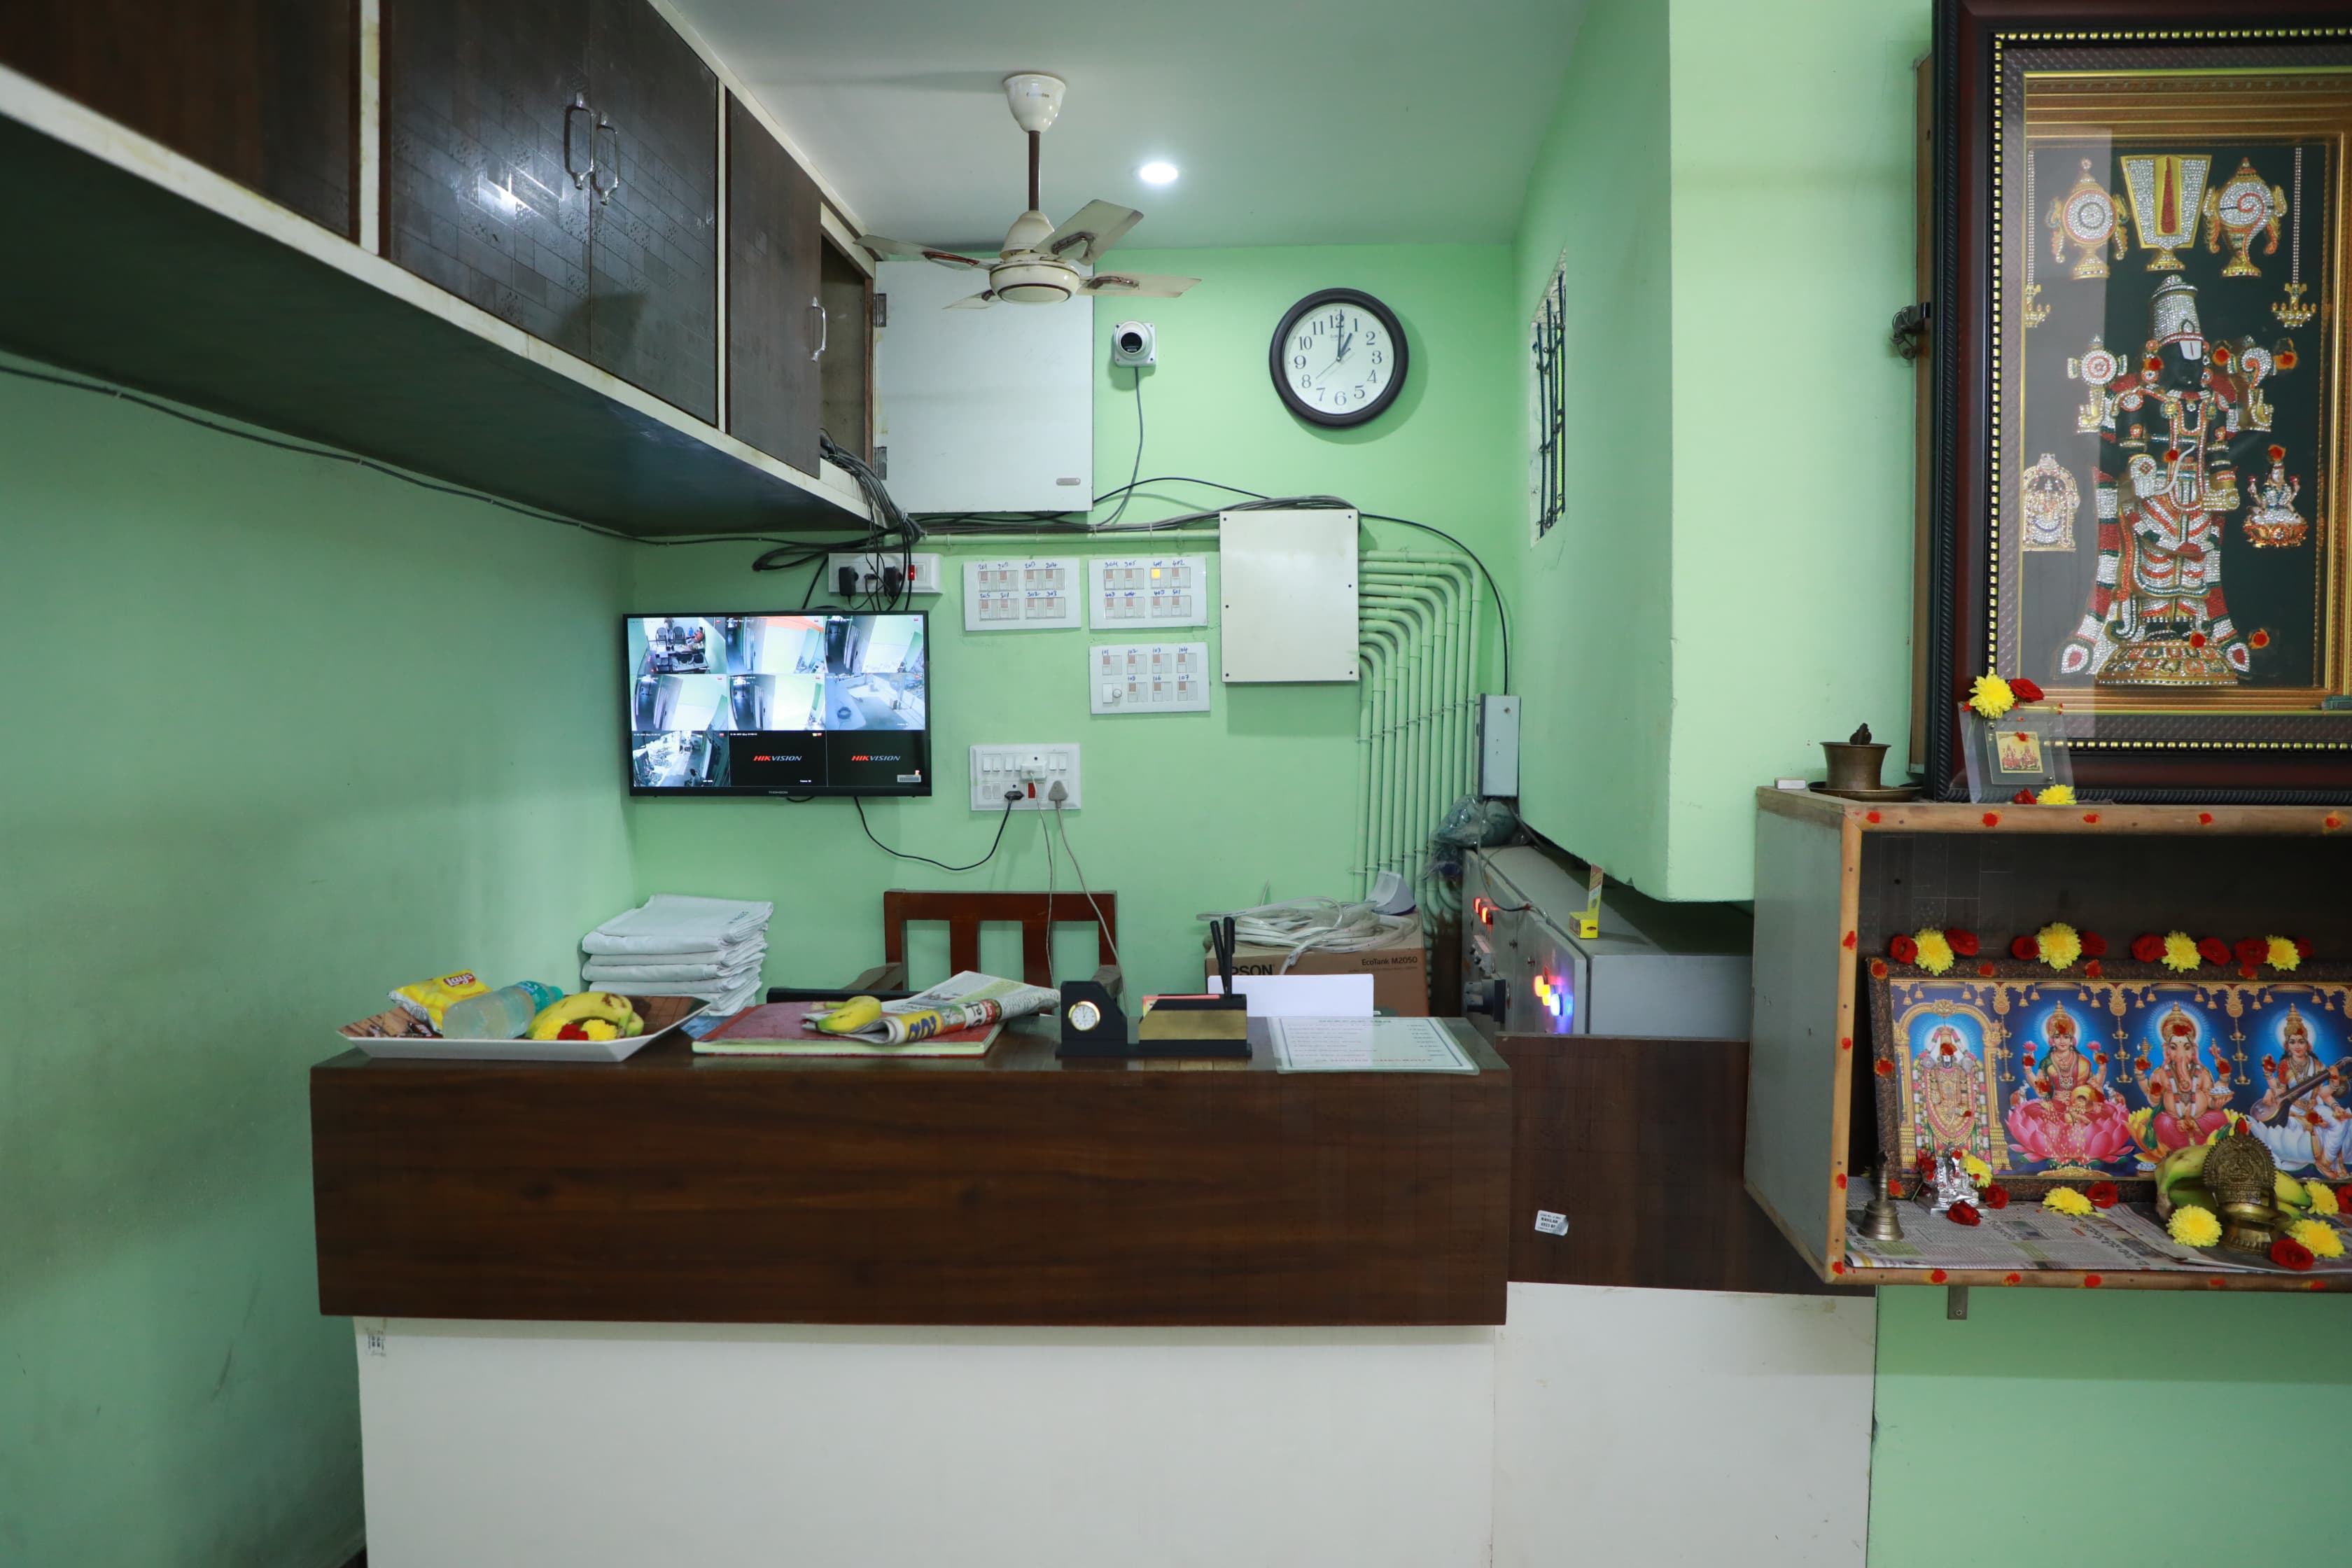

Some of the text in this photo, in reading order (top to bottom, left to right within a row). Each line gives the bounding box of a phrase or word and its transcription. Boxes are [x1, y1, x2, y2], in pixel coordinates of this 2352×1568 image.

[1313, 321, 1324, 335] 11
[1329, 314, 1344, 328] 12
[1354, 318, 1359, 332] 1
[1299, 336, 1312, 350] 10
[1366, 331, 1376, 345] 2
[1294, 355, 1306, 369] 9
[1372, 351, 1382, 364] 3
[1301, 374, 1312, 388] 8
[1367, 370, 1378, 383] 4
[1316, 388, 1326, 401] 7
[1334, 391, 1347, 405] 6
[1354, 385, 1365, 399] 5
[1223, 964, 1273, 975] PSON
